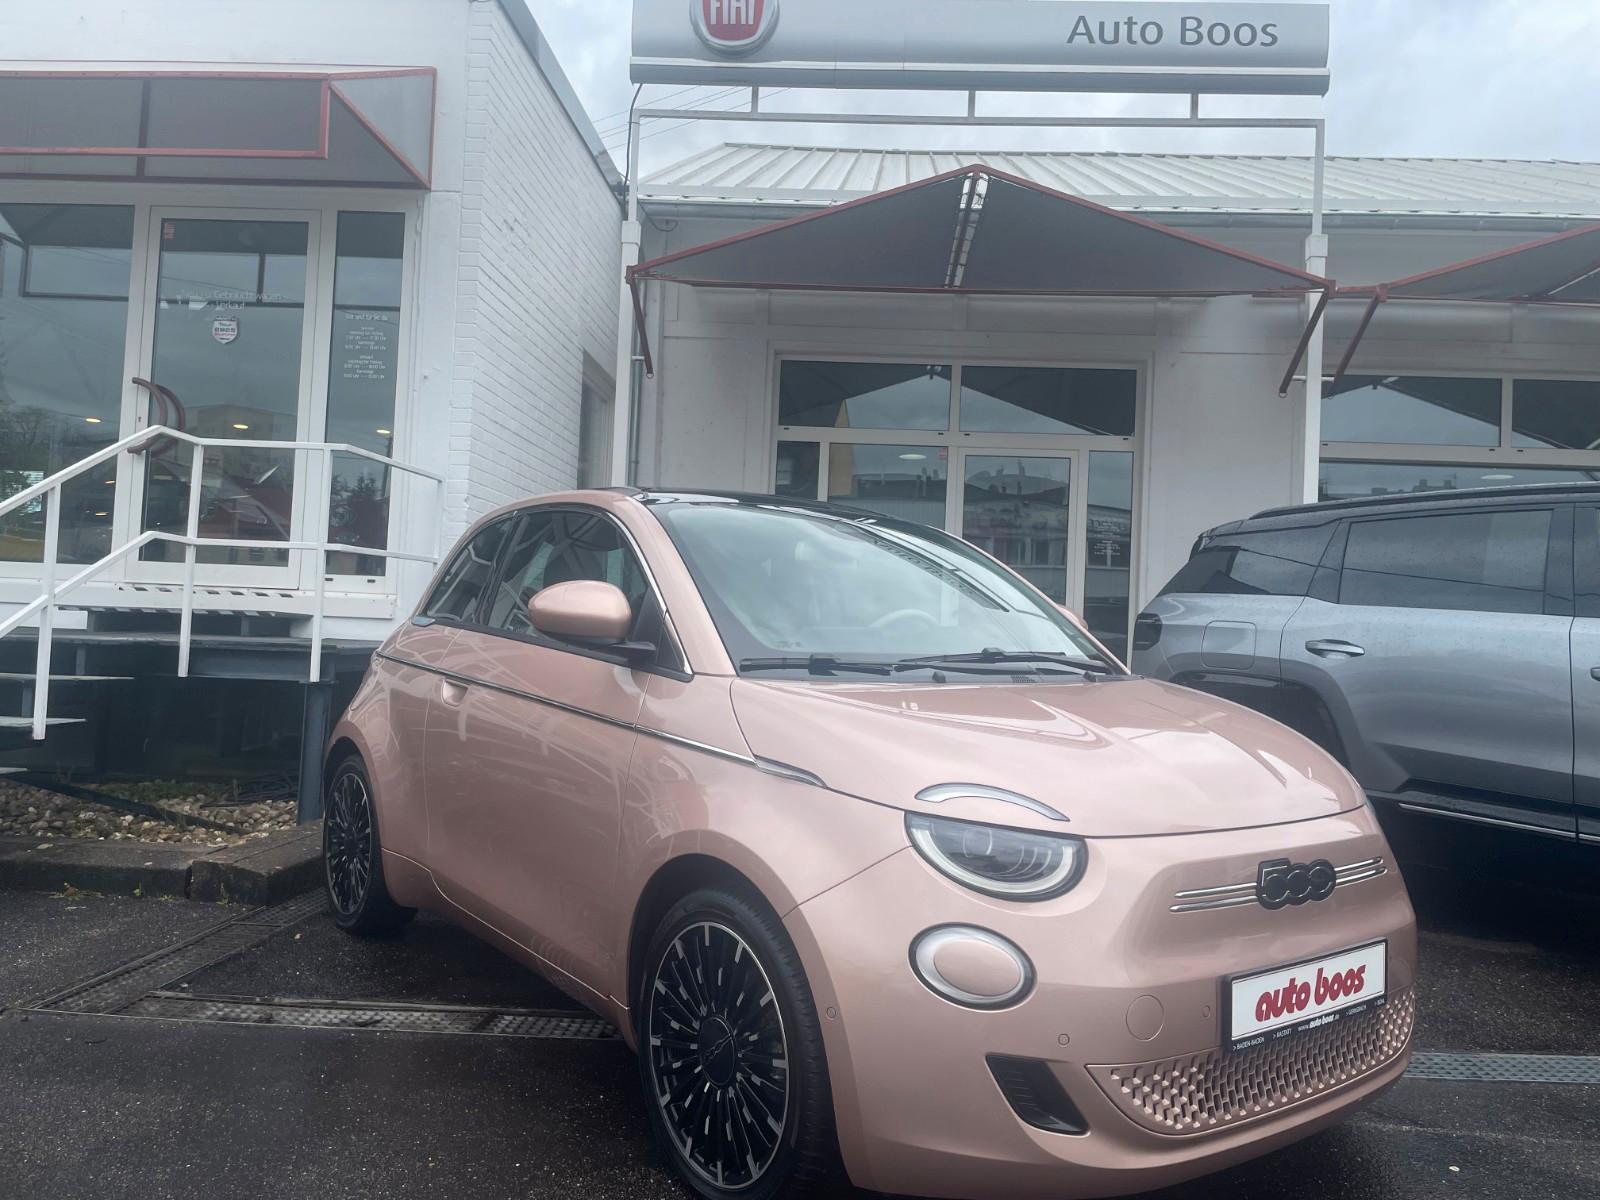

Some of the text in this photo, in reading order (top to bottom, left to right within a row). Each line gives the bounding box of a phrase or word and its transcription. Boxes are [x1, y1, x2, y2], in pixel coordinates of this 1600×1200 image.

[1066, 14, 1279, 47] Auto Boos
[1256, 858, 1336, 910] 500
[1255, 964, 1366, 1022] auto boos
